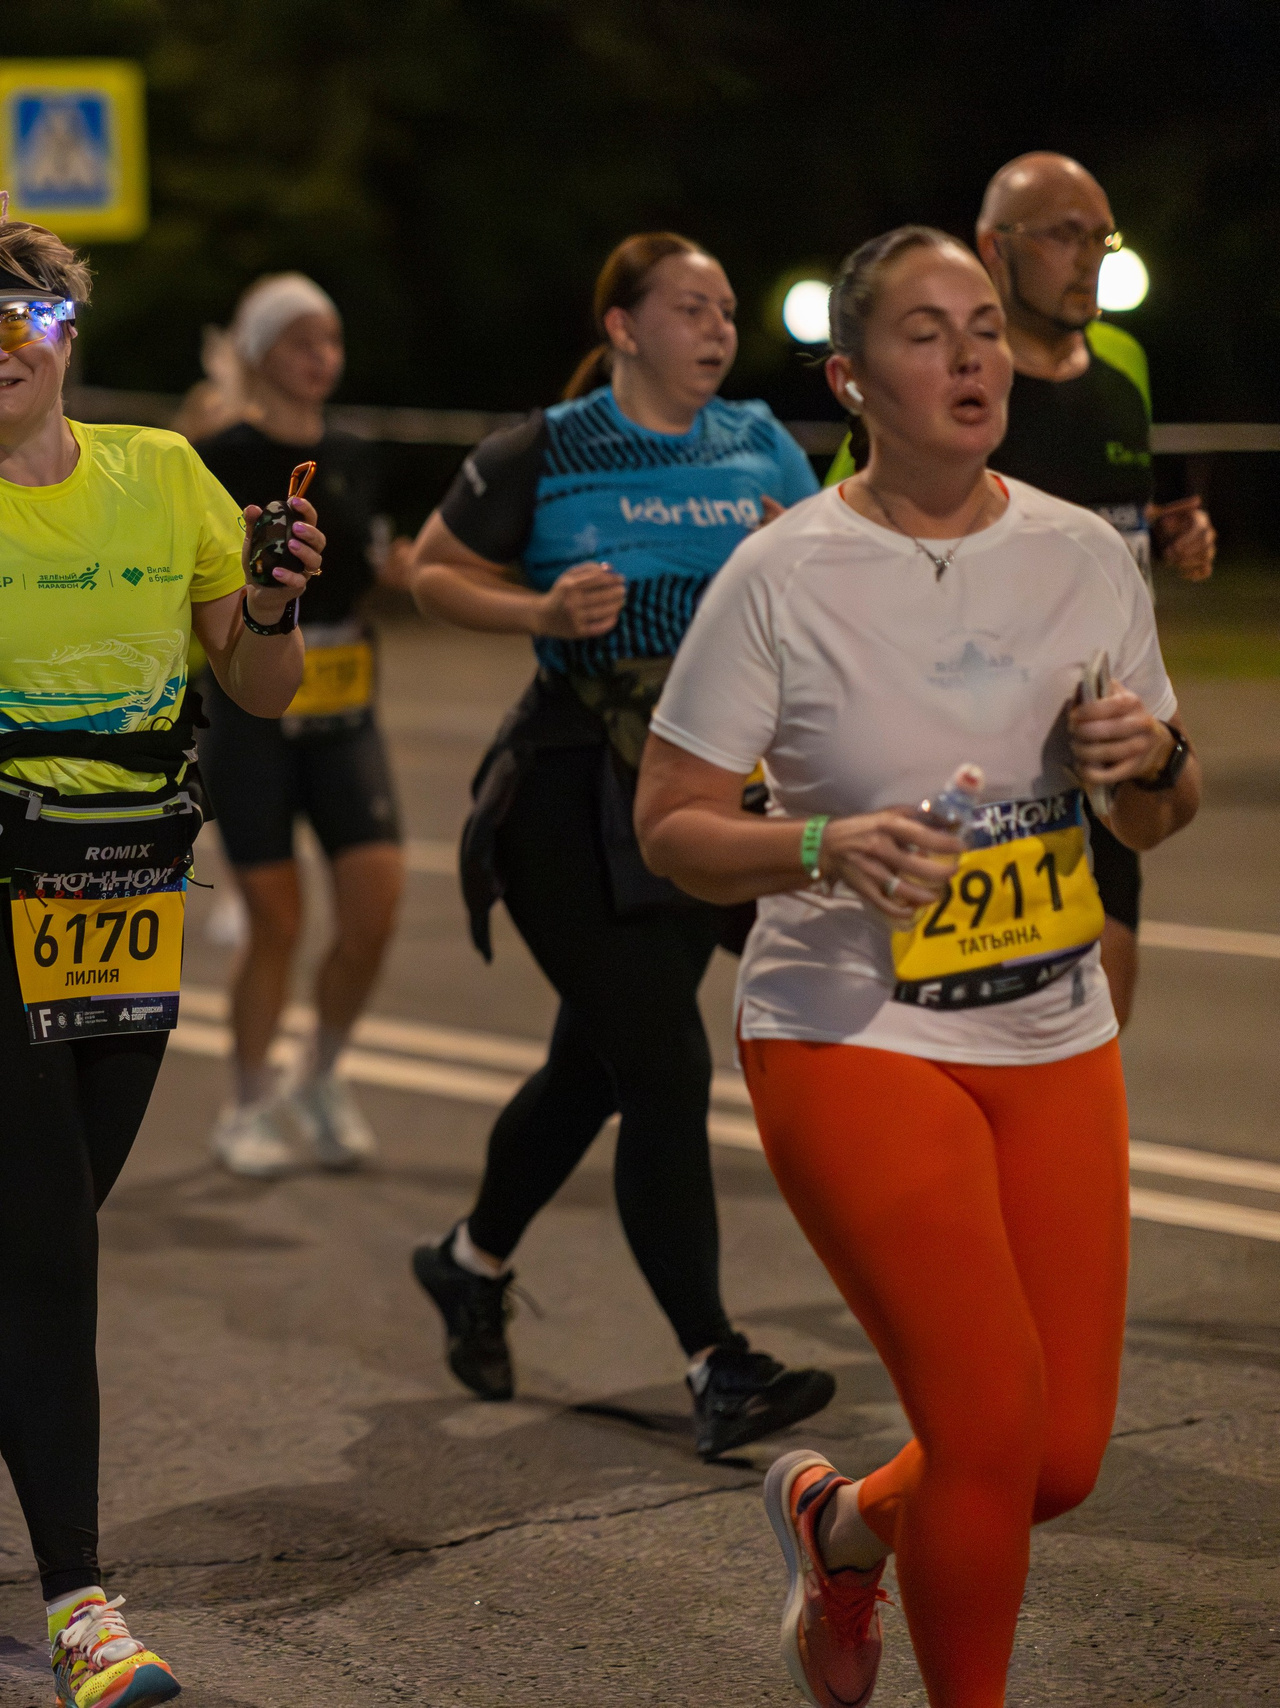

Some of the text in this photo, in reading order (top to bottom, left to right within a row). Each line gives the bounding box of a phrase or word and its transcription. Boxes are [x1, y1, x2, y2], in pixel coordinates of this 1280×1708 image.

[621, 496, 759, 528] körting
[85, 844, 151, 861] ROMIX
[923, 852, 1063, 939] 2911
[33, 908, 160, 968] 6170
[957, 924, 1042, 956] ТАТЬЯНА
[64, 968, 120, 986] ЛИЛИЯ
[39, 1009, 52, 1038] F
